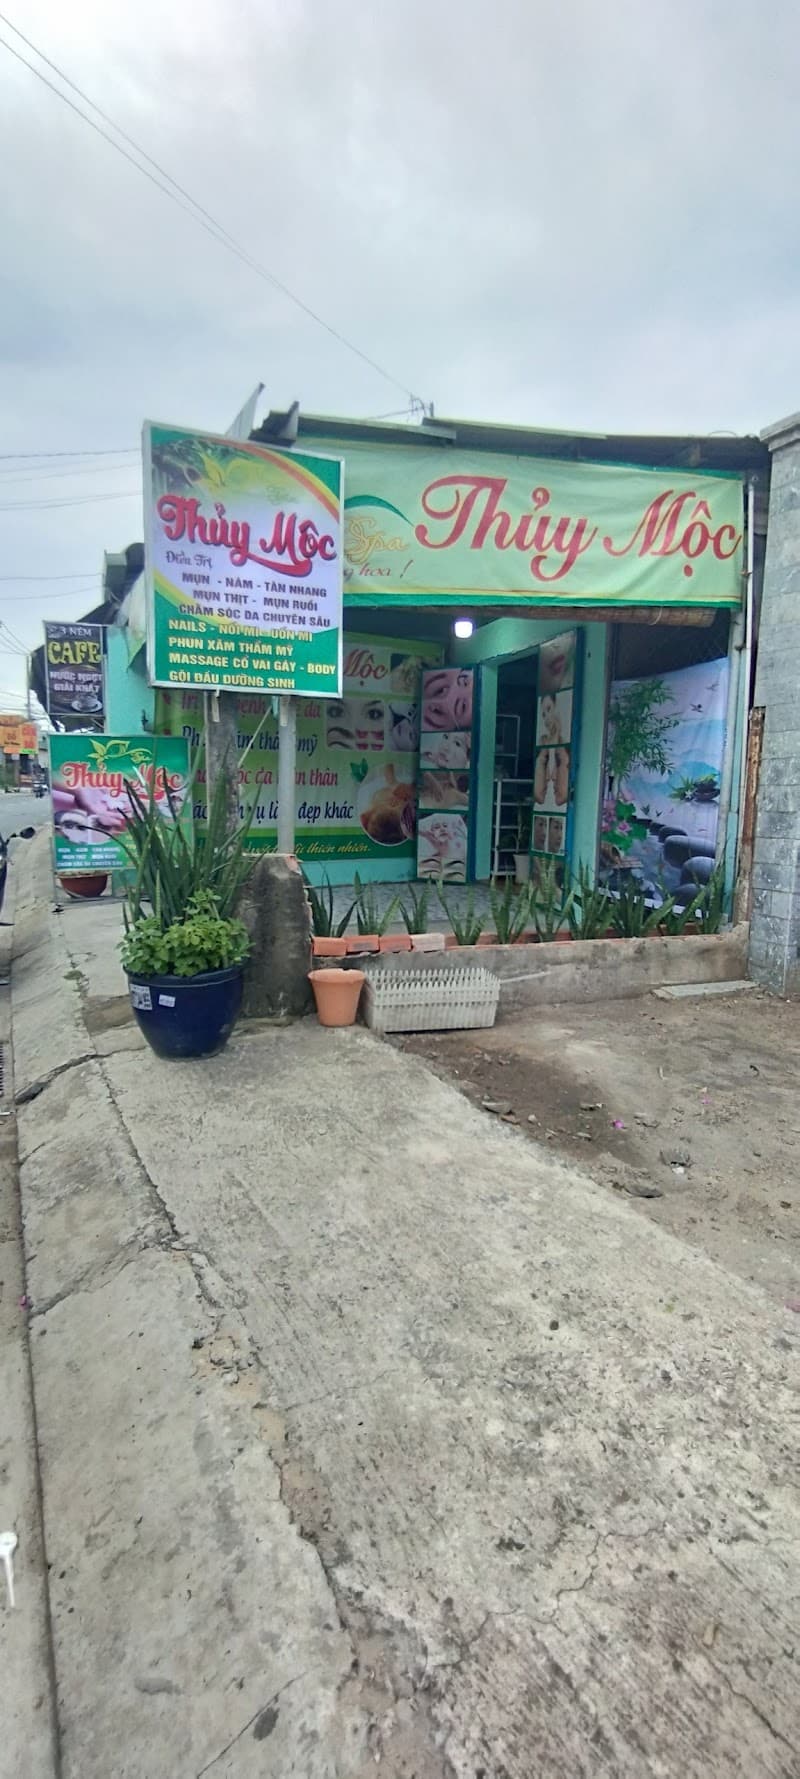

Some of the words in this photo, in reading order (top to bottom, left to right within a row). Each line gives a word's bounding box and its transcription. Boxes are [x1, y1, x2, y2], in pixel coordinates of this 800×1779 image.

[157, 494, 251, 567] Thủy
[415, 475, 597, 582] Thủy
[603, 489, 742, 577] Mộc
[182, 572, 210, 586] MỤN
[289, 585, 327, 598] NHANG
[193, 590, 220, 602] MỤN
[224, 593, 249, 606] THỊT
[263, 597, 290, 609] MỤN
[169, 620, 207, 633] NAILS
[244, 610, 259, 621] DA
[262, 612, 306, 626] CHUYÊN
[309, 616, 331, 628] SÂU
[48, 641, 103, 664] CAFE
[169, 637, 204, 649] PHUN
[169, 653, 229, 667] MASSAGE
[252, 660, 270, 672] VAI
[307, 663, 336, 675] BODY
[267, 678, 295, 689] SINH
[62, 761, 123, 798] Thủy
[299, 801, 321, 824] đẹp
[324, 801, 354, 820] khác
